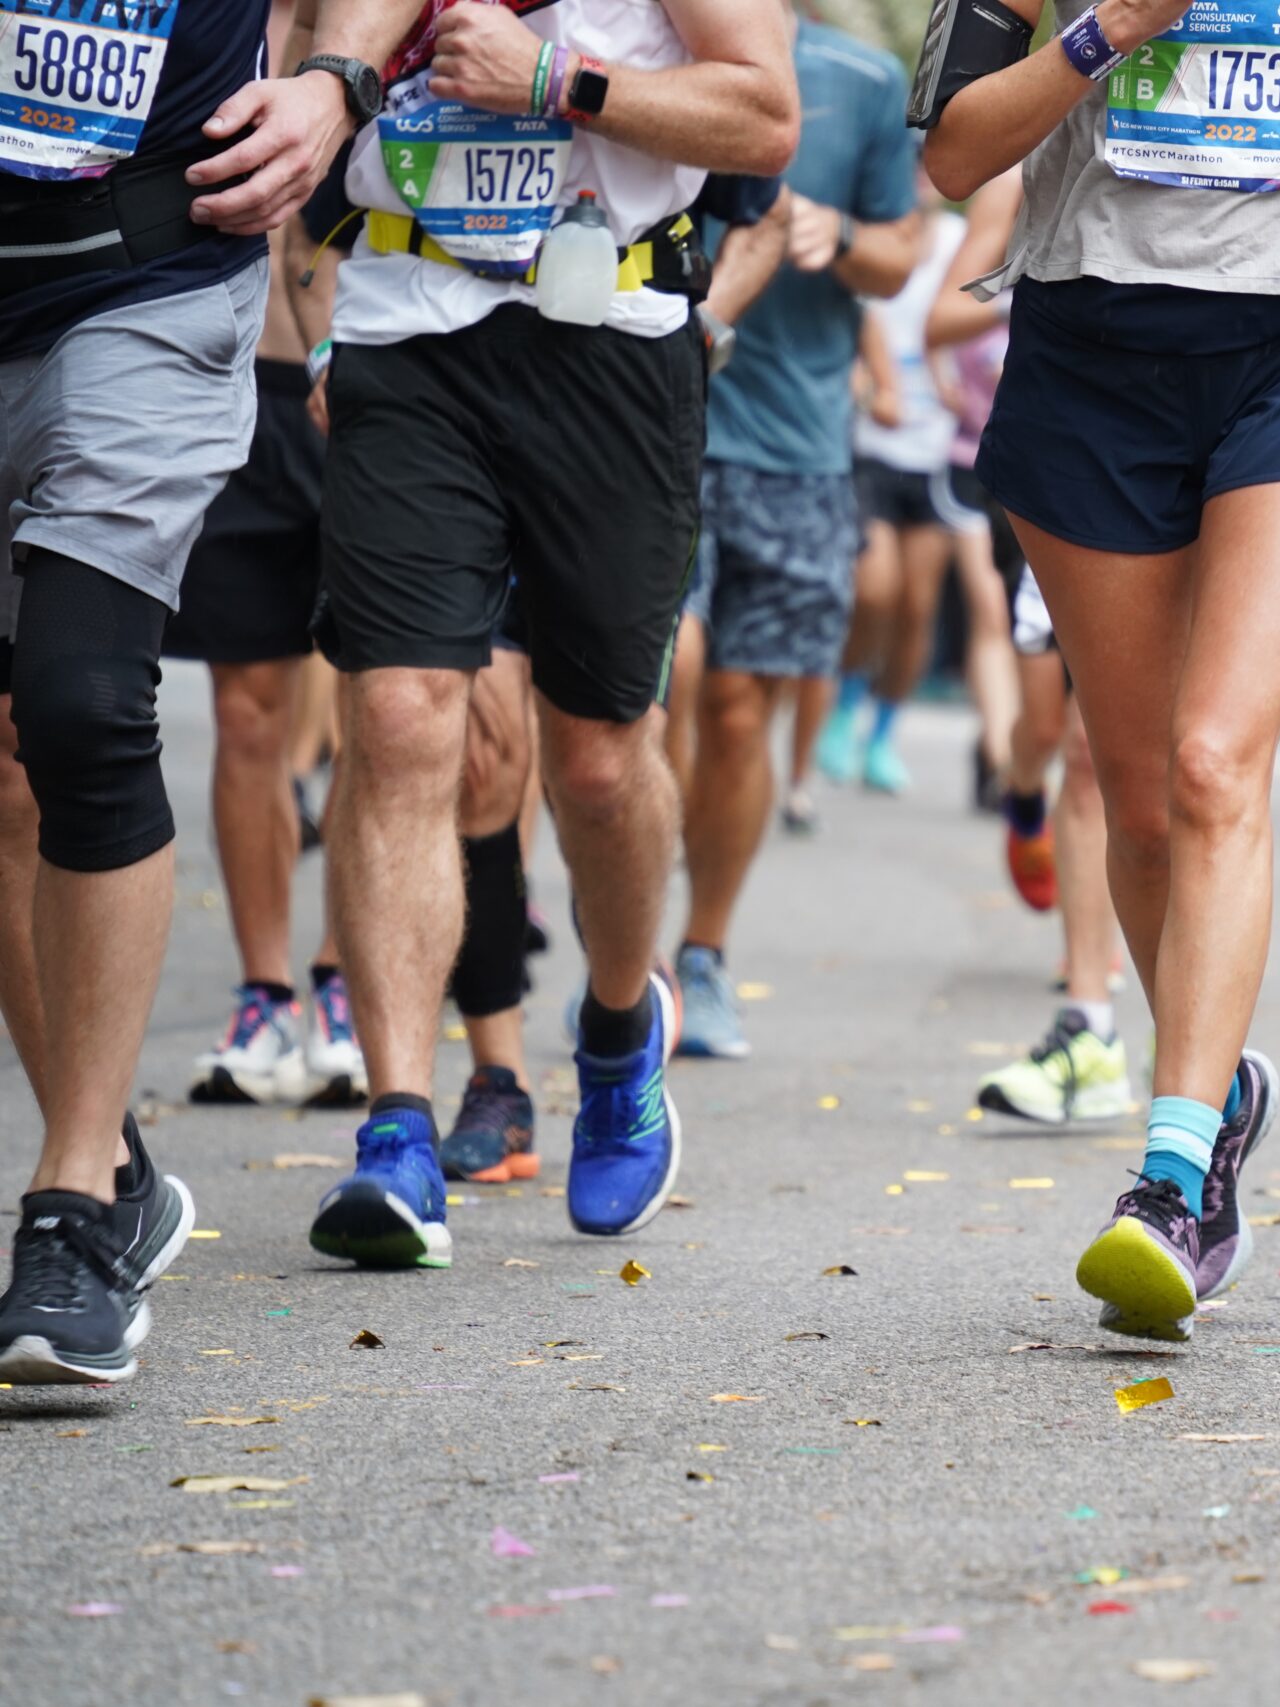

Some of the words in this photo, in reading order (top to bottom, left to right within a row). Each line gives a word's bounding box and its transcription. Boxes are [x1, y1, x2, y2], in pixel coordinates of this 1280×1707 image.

[1192, 2, 1219, 11] TATA
[1189, 12, 1256, 23] CONSULTANCY
[1189, 23, 1232, 33] SERVICES
[1139, 45, 1155, 65] 2
[14, 24, 152, 111] 58885
[1136, 78, 1154, 100] B
[19, 105, 76, 133] 2022
[513, 120, 548, 132] TATA
[1204, 124, 1256, 142] 2022
[399, 149, 415, 168] 2
[1112, 147, 1223, 163] #TCSNYCMarathon
[1253, 155, 1280, 164] move
[465, 148, 555, 202] 15725
[1190, 176, 1213, 187] FERRY
[403, 179, 420, 198] A
[463, 215, 507, 230] 2022
